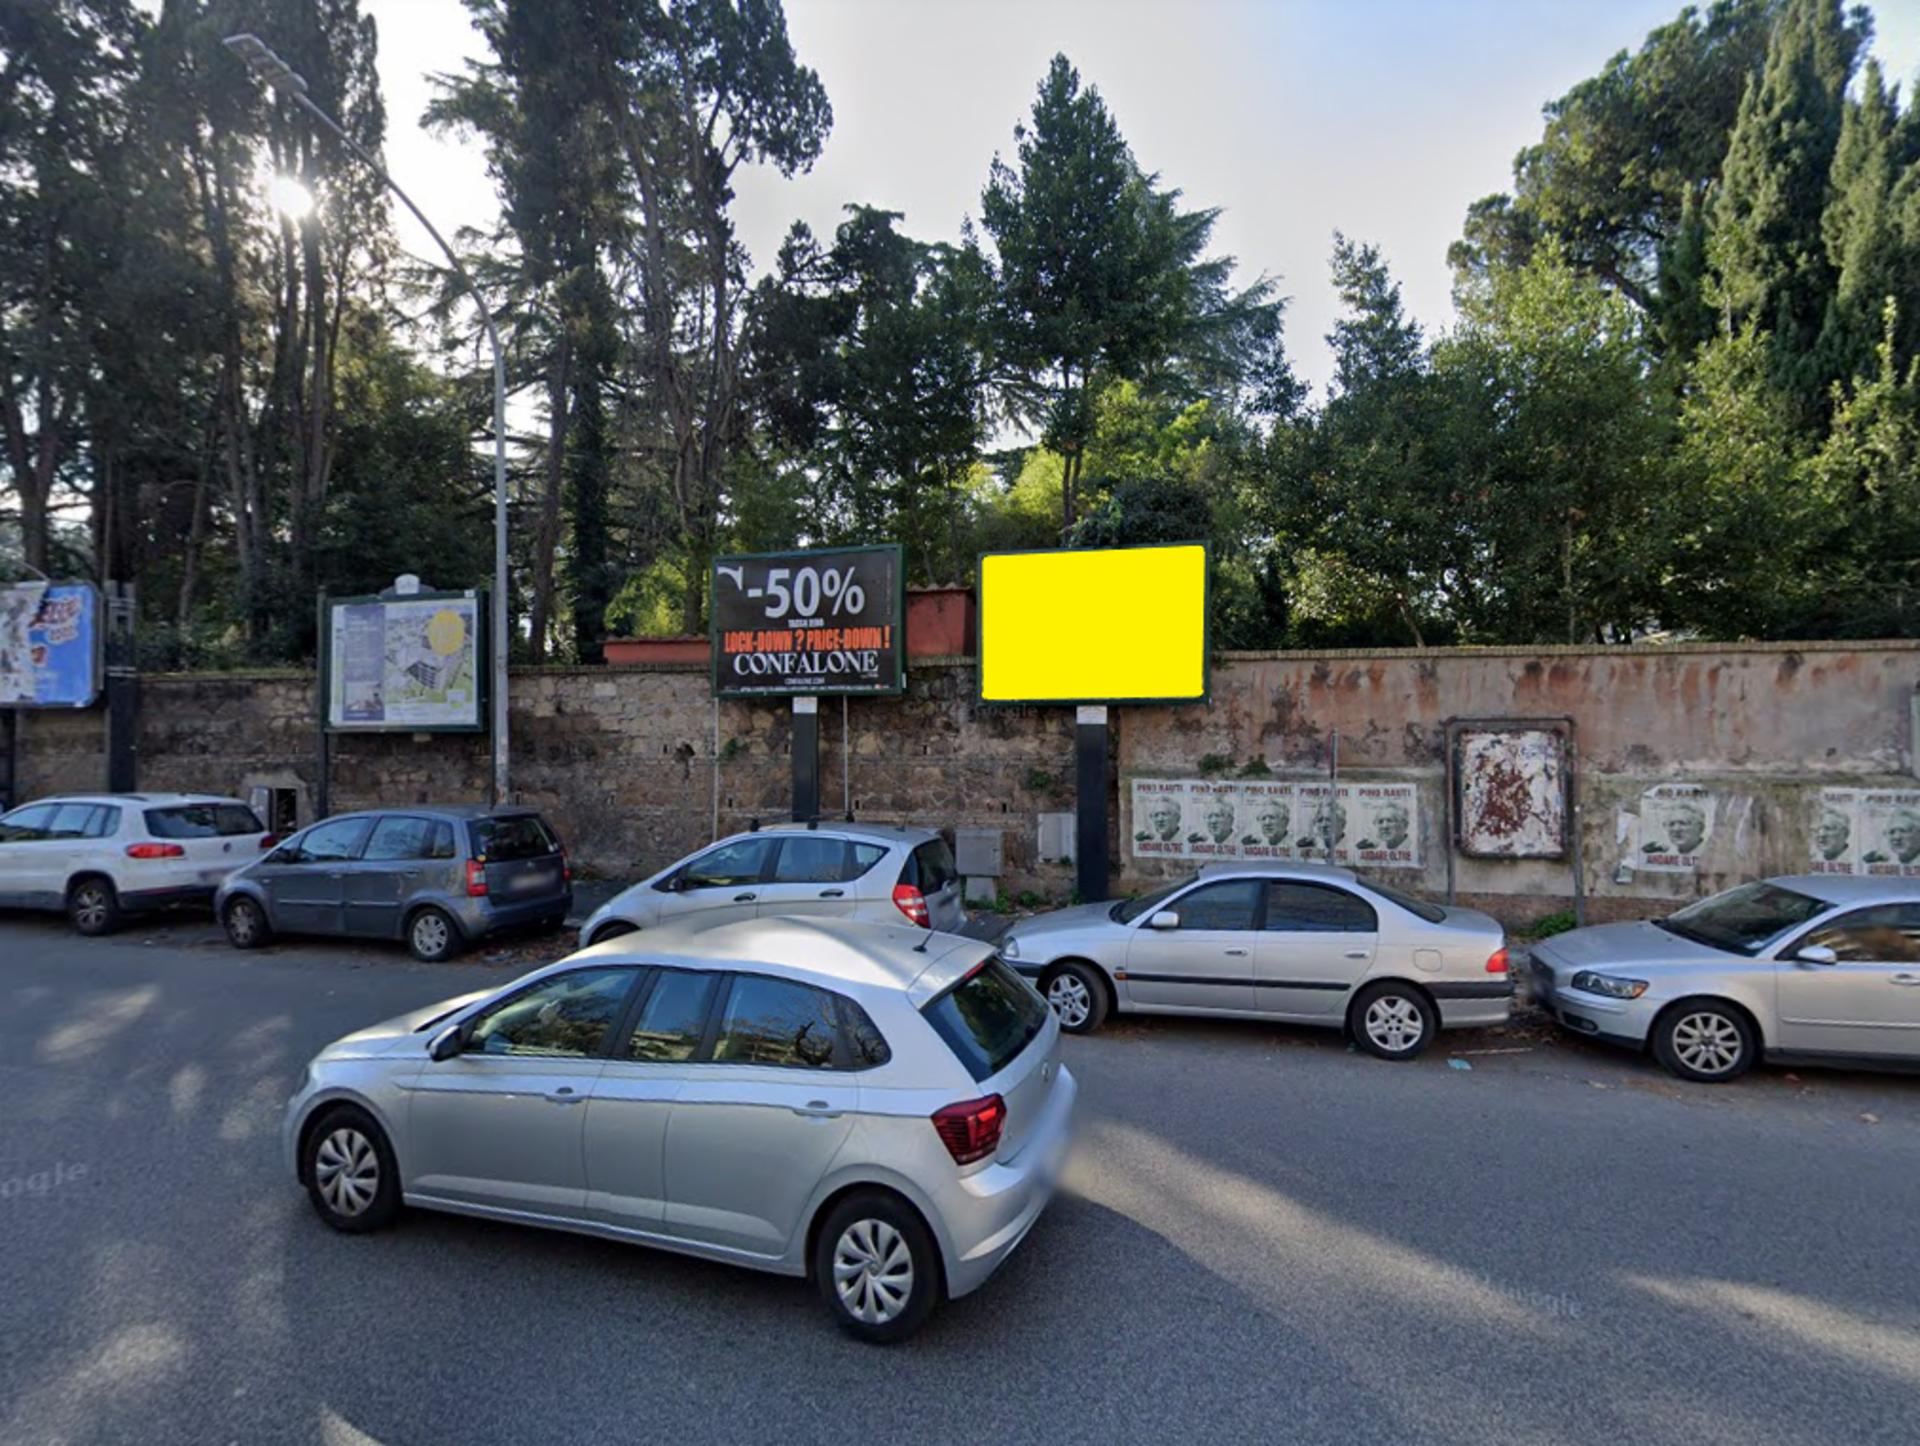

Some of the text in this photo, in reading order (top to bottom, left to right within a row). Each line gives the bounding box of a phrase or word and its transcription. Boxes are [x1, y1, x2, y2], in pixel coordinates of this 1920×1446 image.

[747, 566, 865, 618] -50%
[724, 624, 891, 653] LOCK-DOWN ? PRICE-DOWN !
[733, 651, 879, 675] CONFALONE
[1359, 788, 1381, 797] PINO
